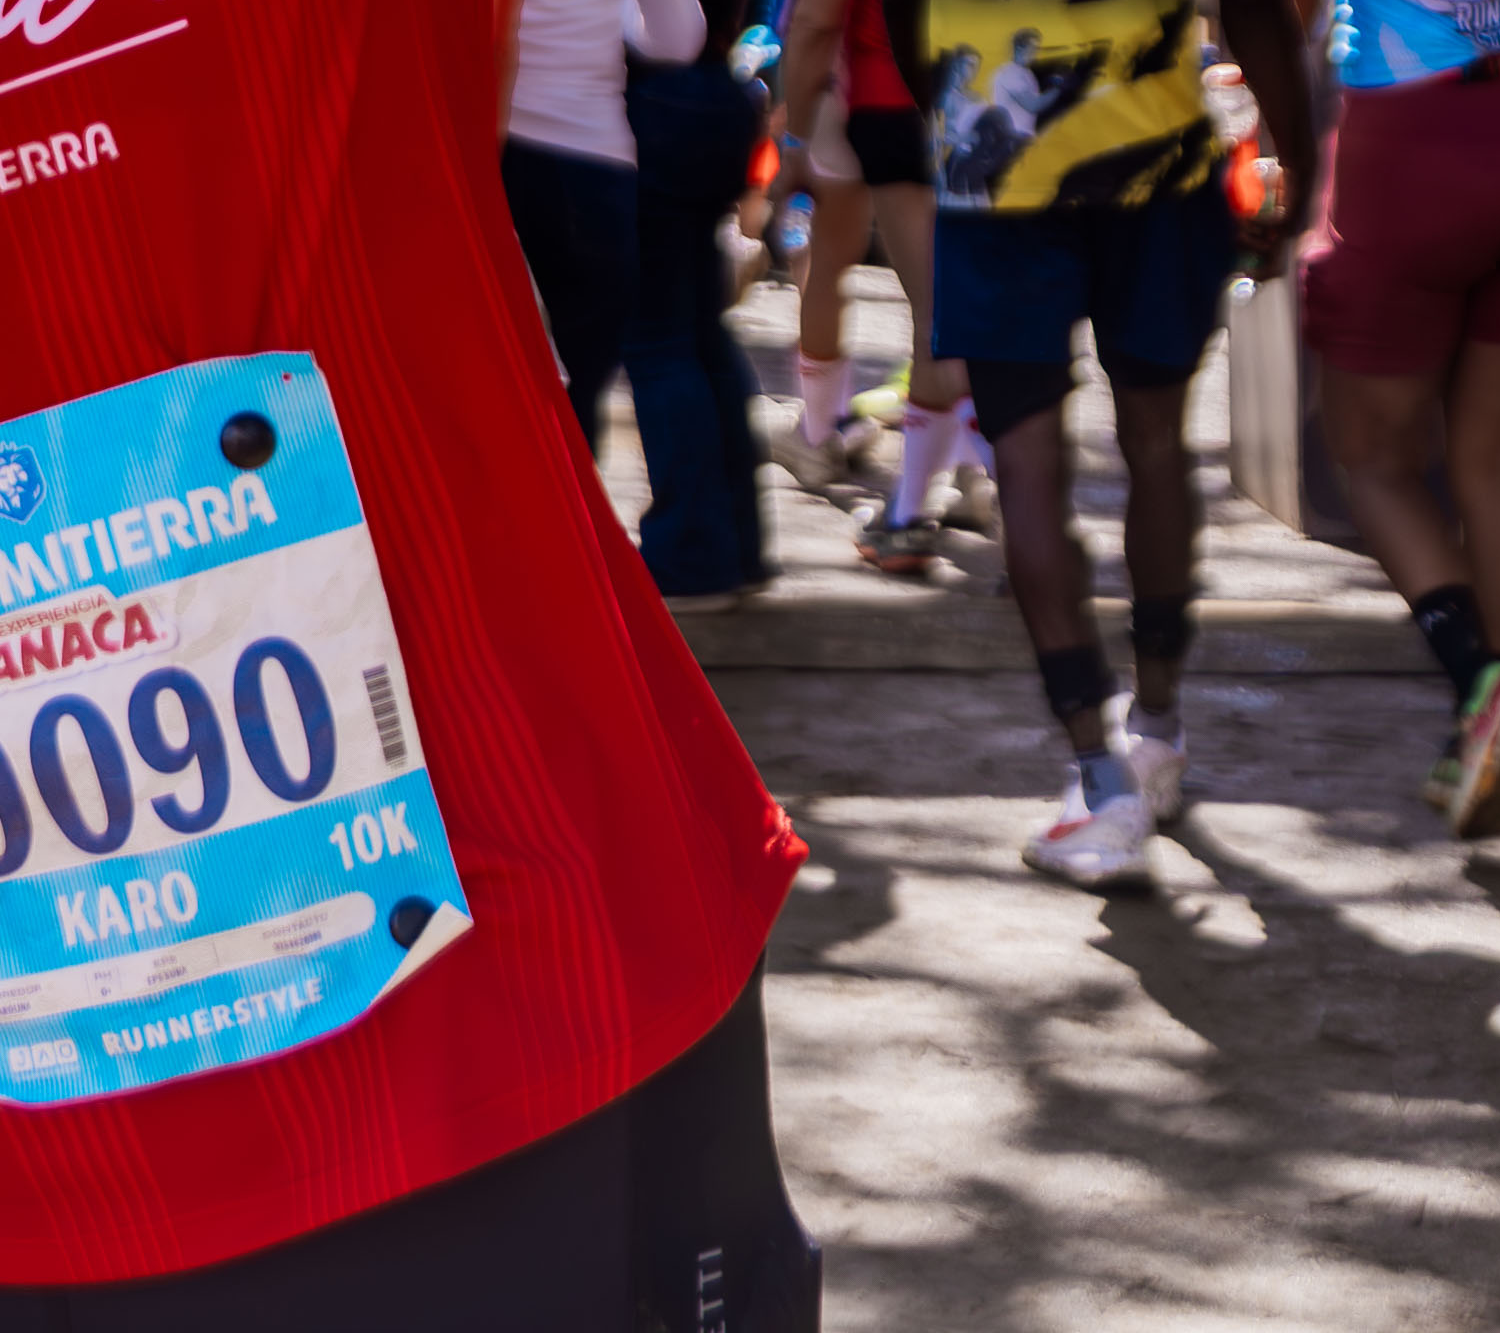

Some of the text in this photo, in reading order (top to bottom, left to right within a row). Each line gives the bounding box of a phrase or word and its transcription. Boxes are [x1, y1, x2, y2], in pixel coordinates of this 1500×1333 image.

[328, 801, 418, 872] 10K
[56, 869, 199, 950] KARO
[101, 977, 325, 1056] RUNNERSTYLE
